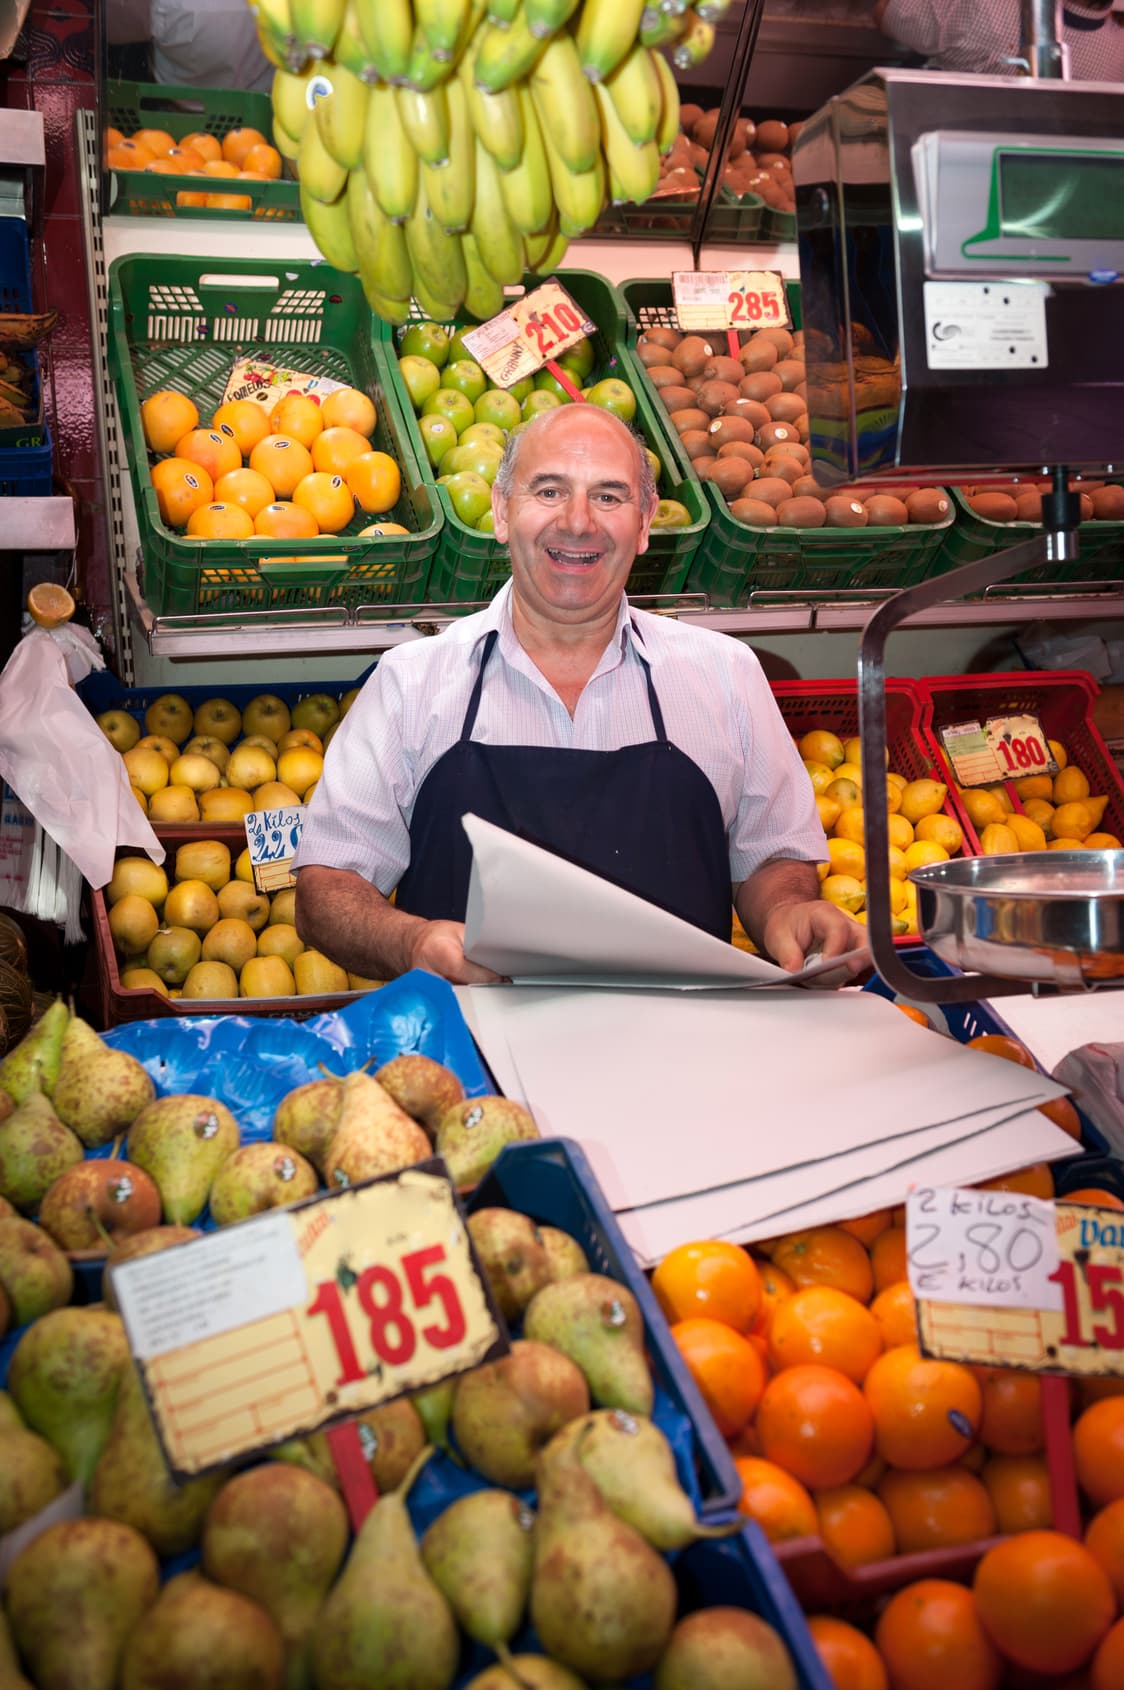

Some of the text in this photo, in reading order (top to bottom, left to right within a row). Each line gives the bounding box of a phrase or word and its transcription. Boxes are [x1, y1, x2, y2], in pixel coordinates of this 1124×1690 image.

[728, 292, 780, 321] 285
[525, 303, 581, 353] 210
[501, 343, 524, 381] GRANNY
[996, 735, 1046, 771] 180
[247, 813, 262, 836] 2
[917, 1189, 937, 1213] 2
[910, 1222, 1044, 1274] 2,80
[306, 1242, 467, 1387] 185
